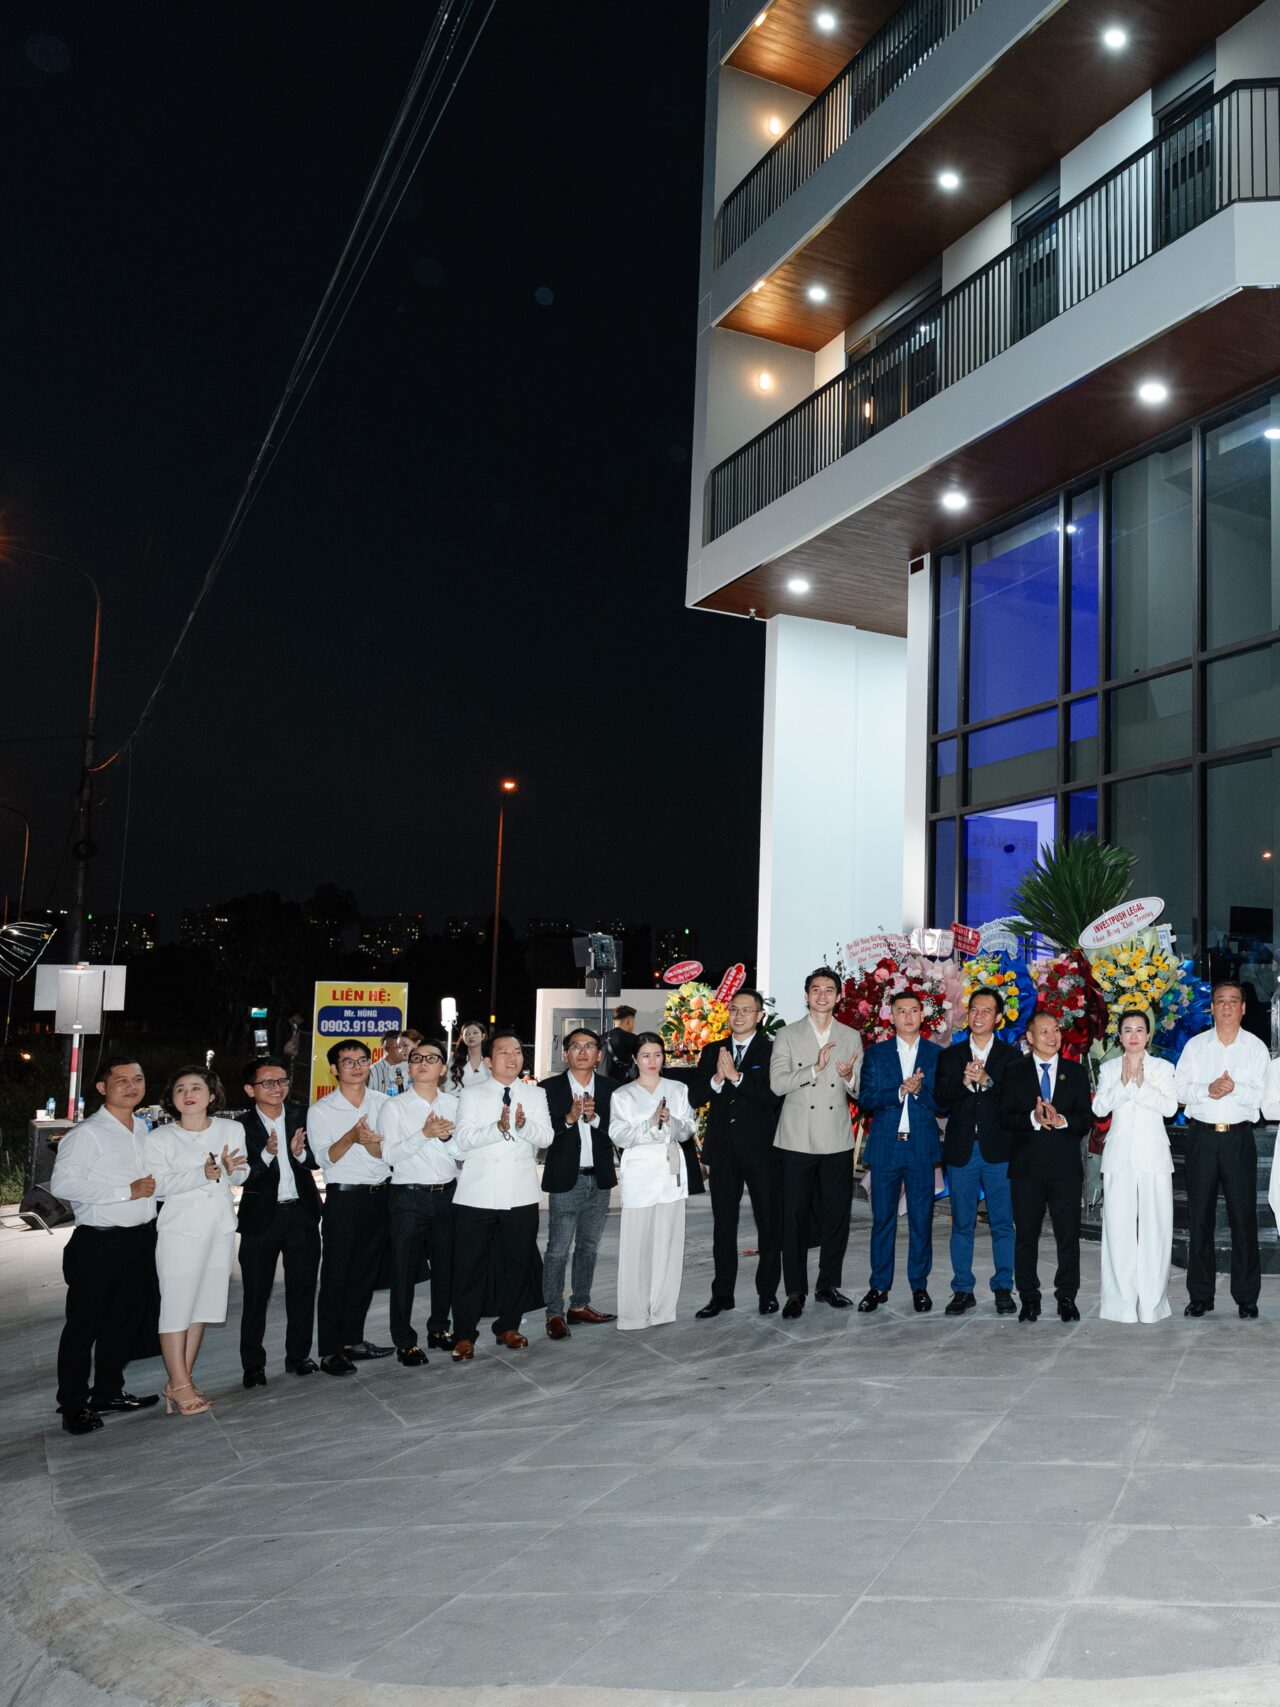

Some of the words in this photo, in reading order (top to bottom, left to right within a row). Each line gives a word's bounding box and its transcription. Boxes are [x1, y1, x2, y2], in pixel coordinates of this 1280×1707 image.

[1093, 911, 1127, 934] INVESTPUSH
[1126, 902, 1145, 916] LEGAL
[332, 988, 364, 1001] LIÊN
[368, 988, 391, 1004] HỆ:
[343, 1009, 356, 1017] Mr.
[320, 1020, 400, 1032] 0903.919.838
